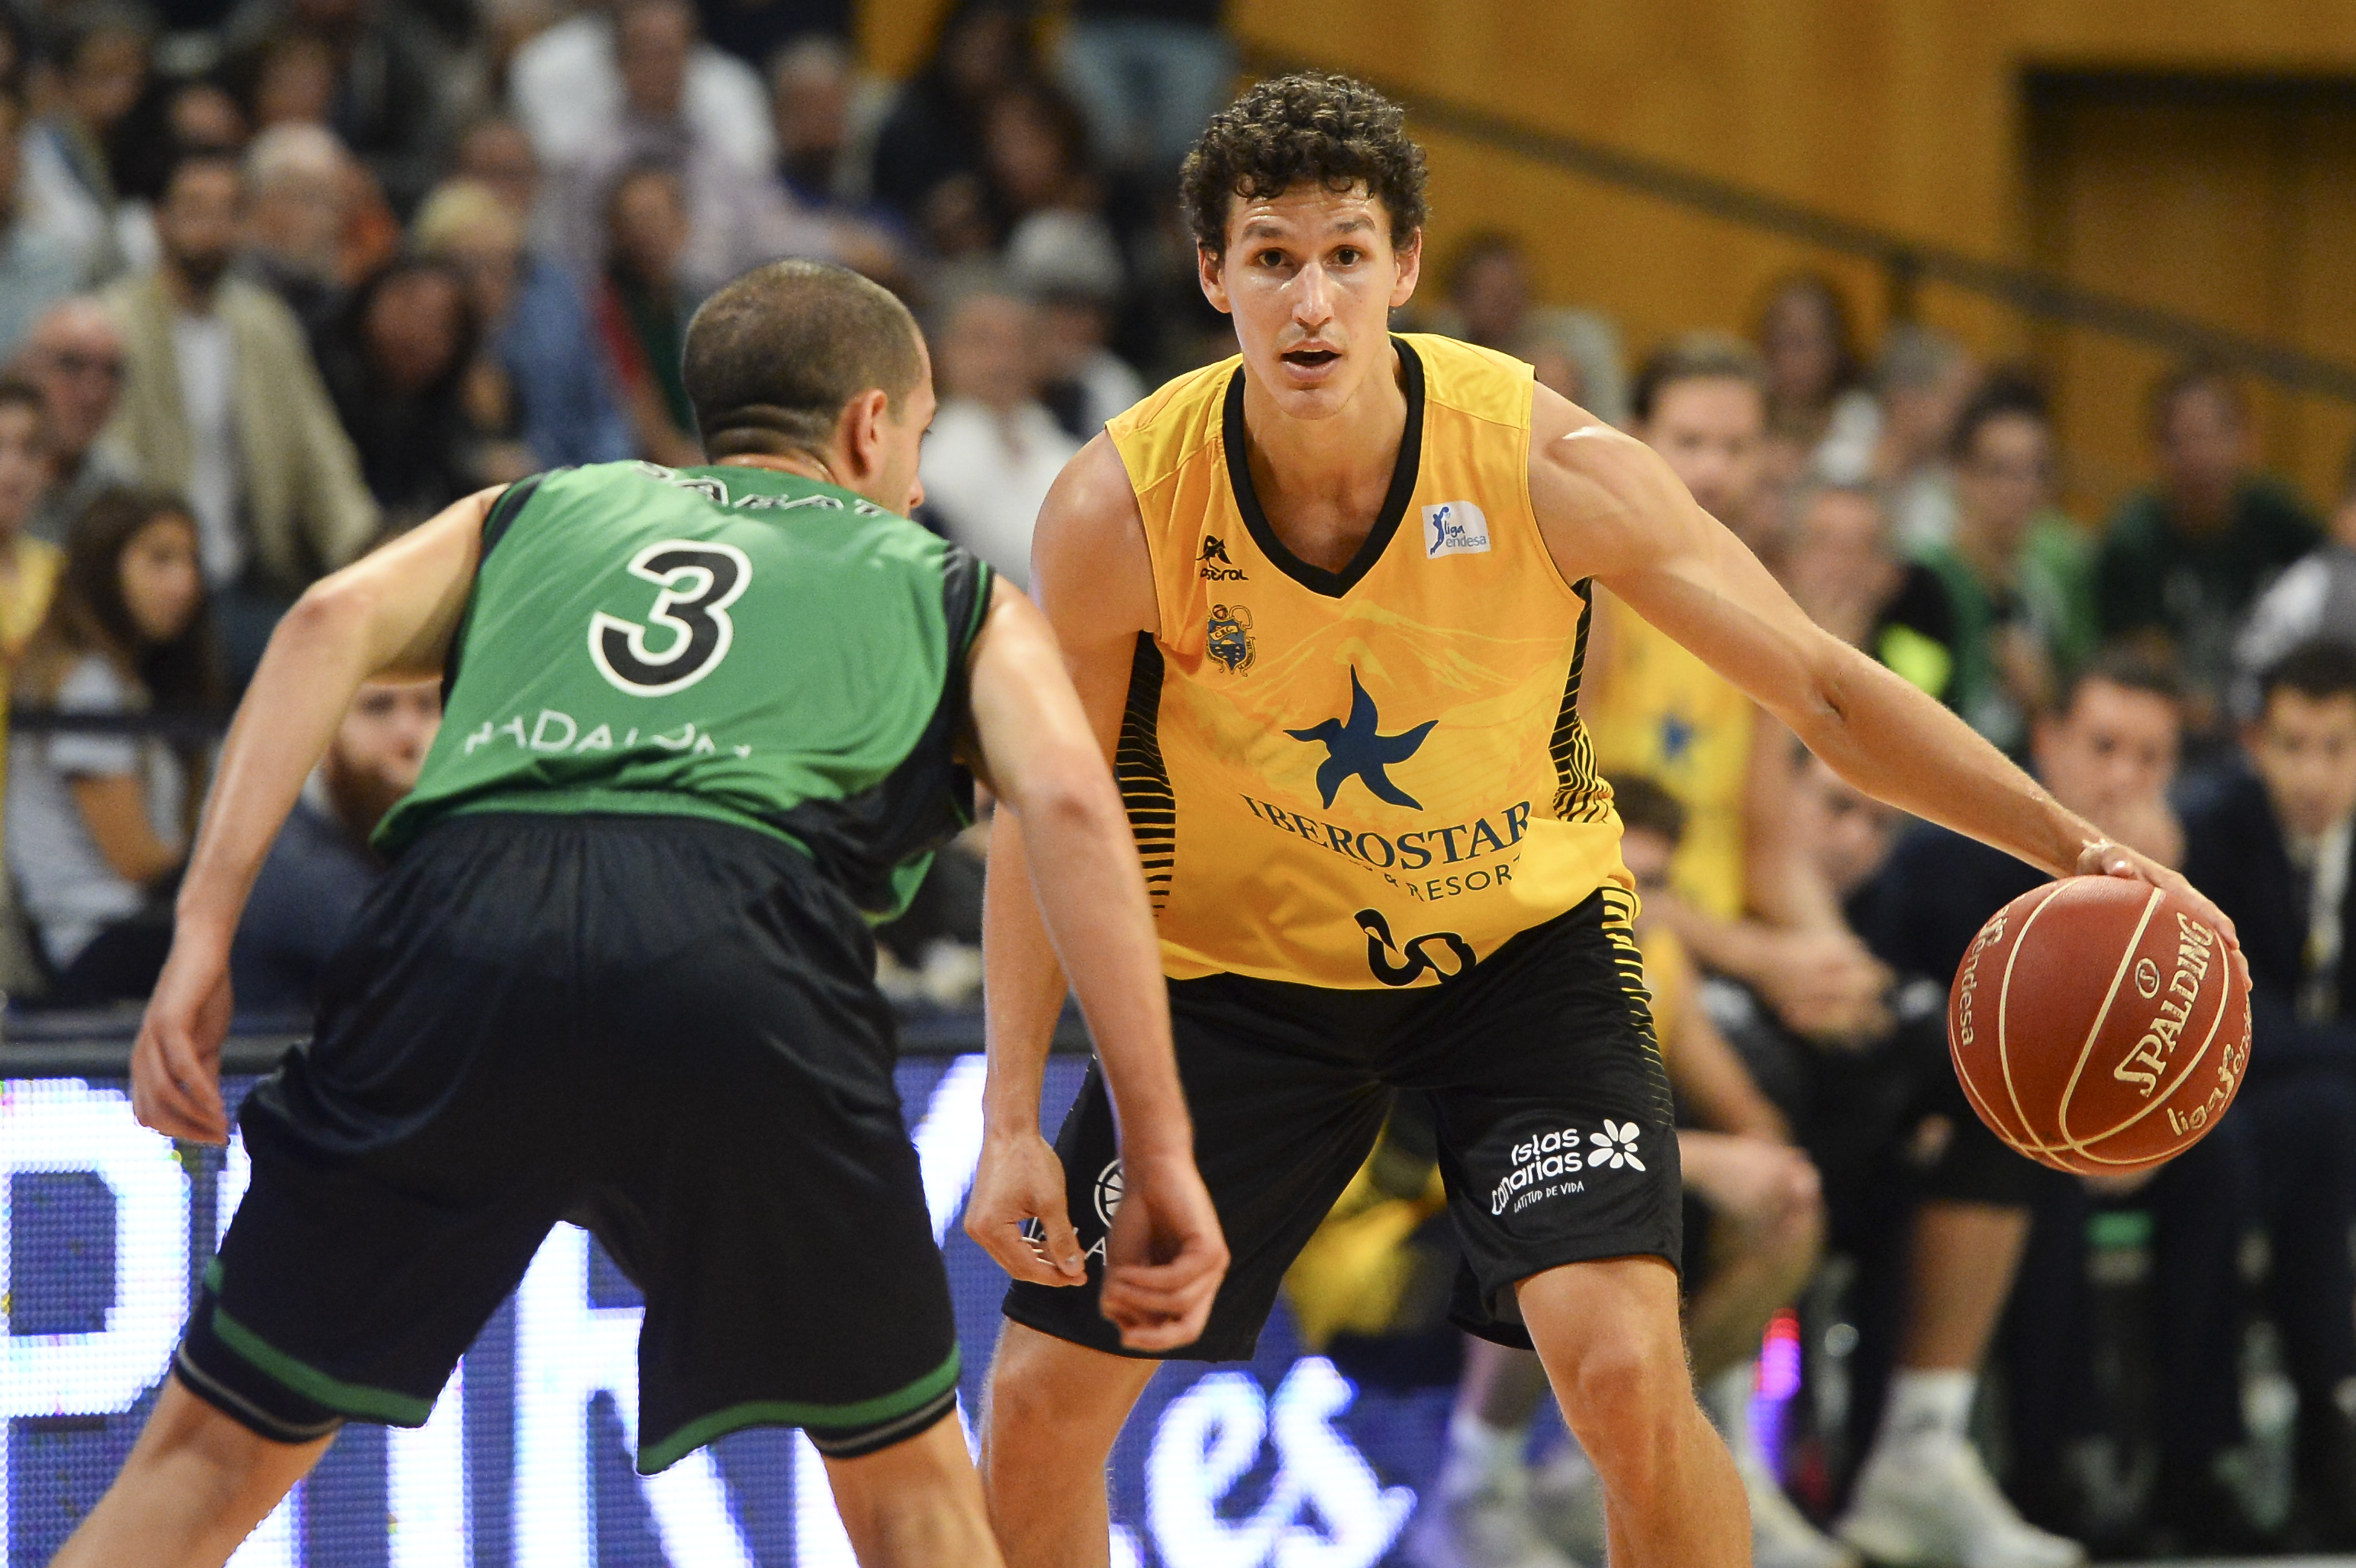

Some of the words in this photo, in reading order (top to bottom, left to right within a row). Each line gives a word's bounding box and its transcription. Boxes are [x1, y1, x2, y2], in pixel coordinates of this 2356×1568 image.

[1444, 521, 1465, 538] liga
[1446, 535, 1486, 547] endesa
[588, 539, 753, 697] 3
[1238, 793, 1531, 870] IBEROSTAR
[2114, 912, 2215, 1098] SPALDING
[1514, 1190, 1543, 1213] LATITUD
[1546, 1185, 1558, 1198] DE
[1560, 1180, 1584, 1195] VIDA
